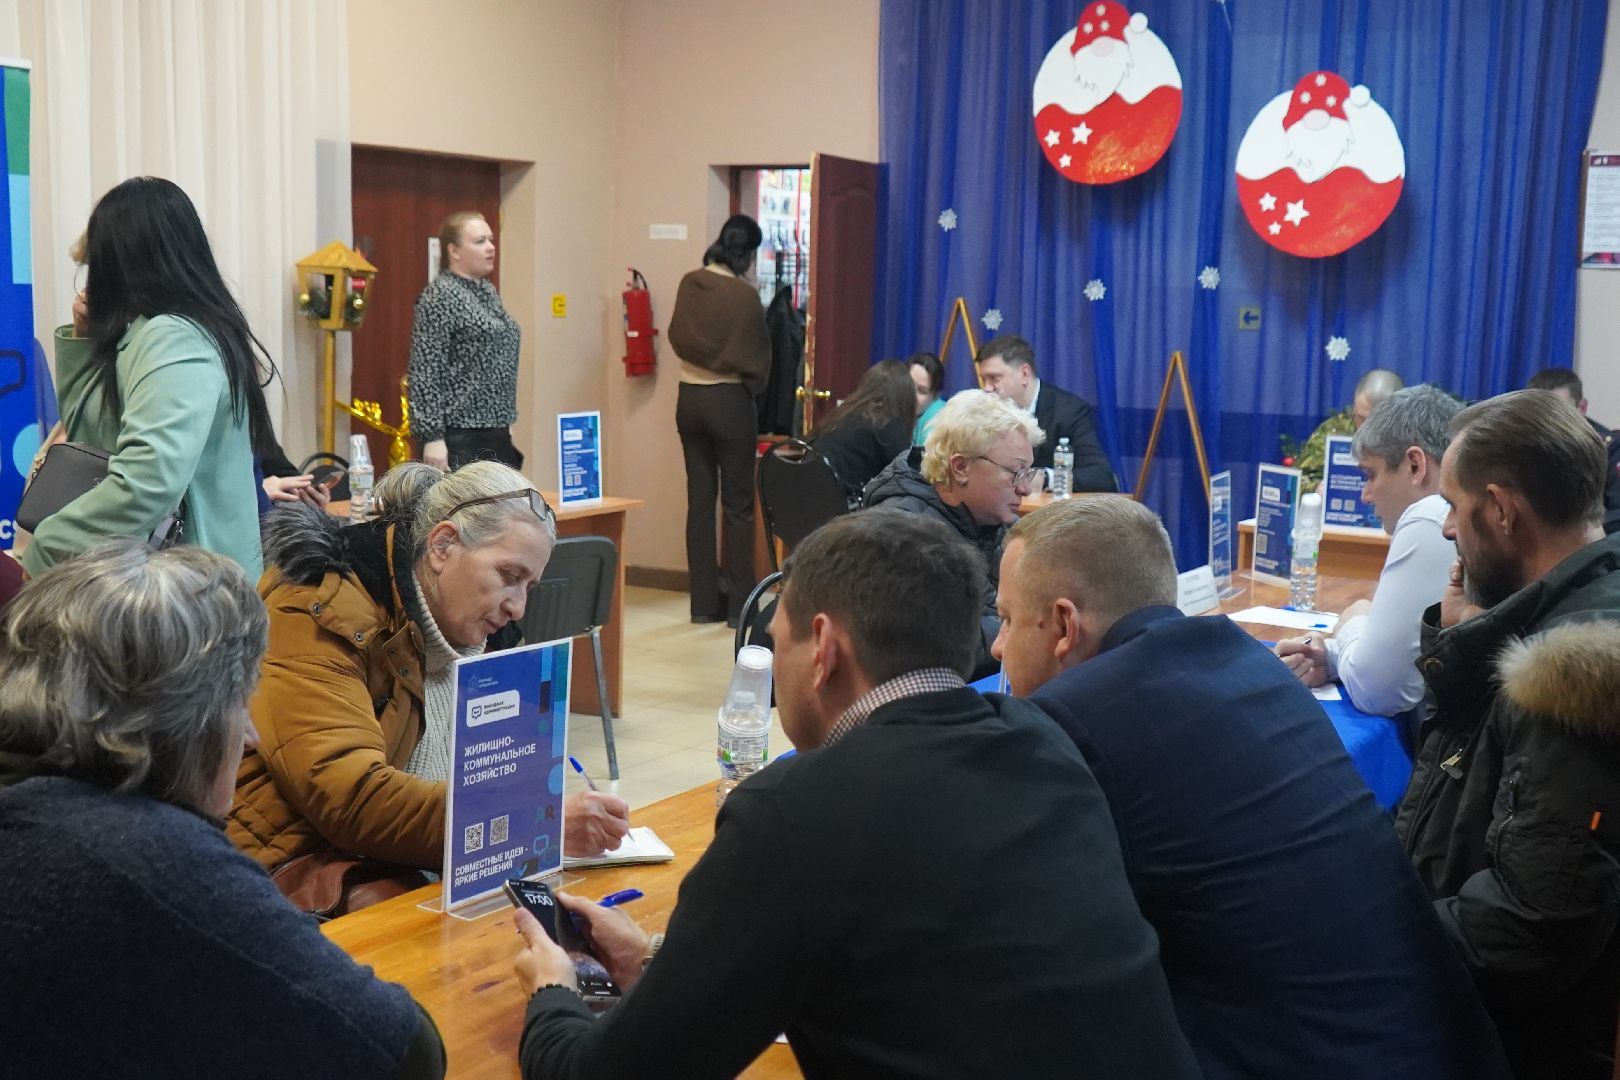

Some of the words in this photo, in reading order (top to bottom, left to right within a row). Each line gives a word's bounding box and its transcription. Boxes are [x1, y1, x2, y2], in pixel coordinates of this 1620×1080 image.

[463, 743, 536, 772] КОММУНАЛЬНОЕ
[464, 736, 515, 757] ЖИЛИЩНО-
[462, 763, 517, 787] ХОЗЯЙСТВО
[454, 874, 479, 887] ЯРКИЕ
[479, 860, 513, 878] РЕШЕНИЯ
[455, 853, 503, 876] СОВМЕСТНЫЕ
[504, 846, 524, 861] ИДЕИ
[524, 893, 554, 906] 17:00
